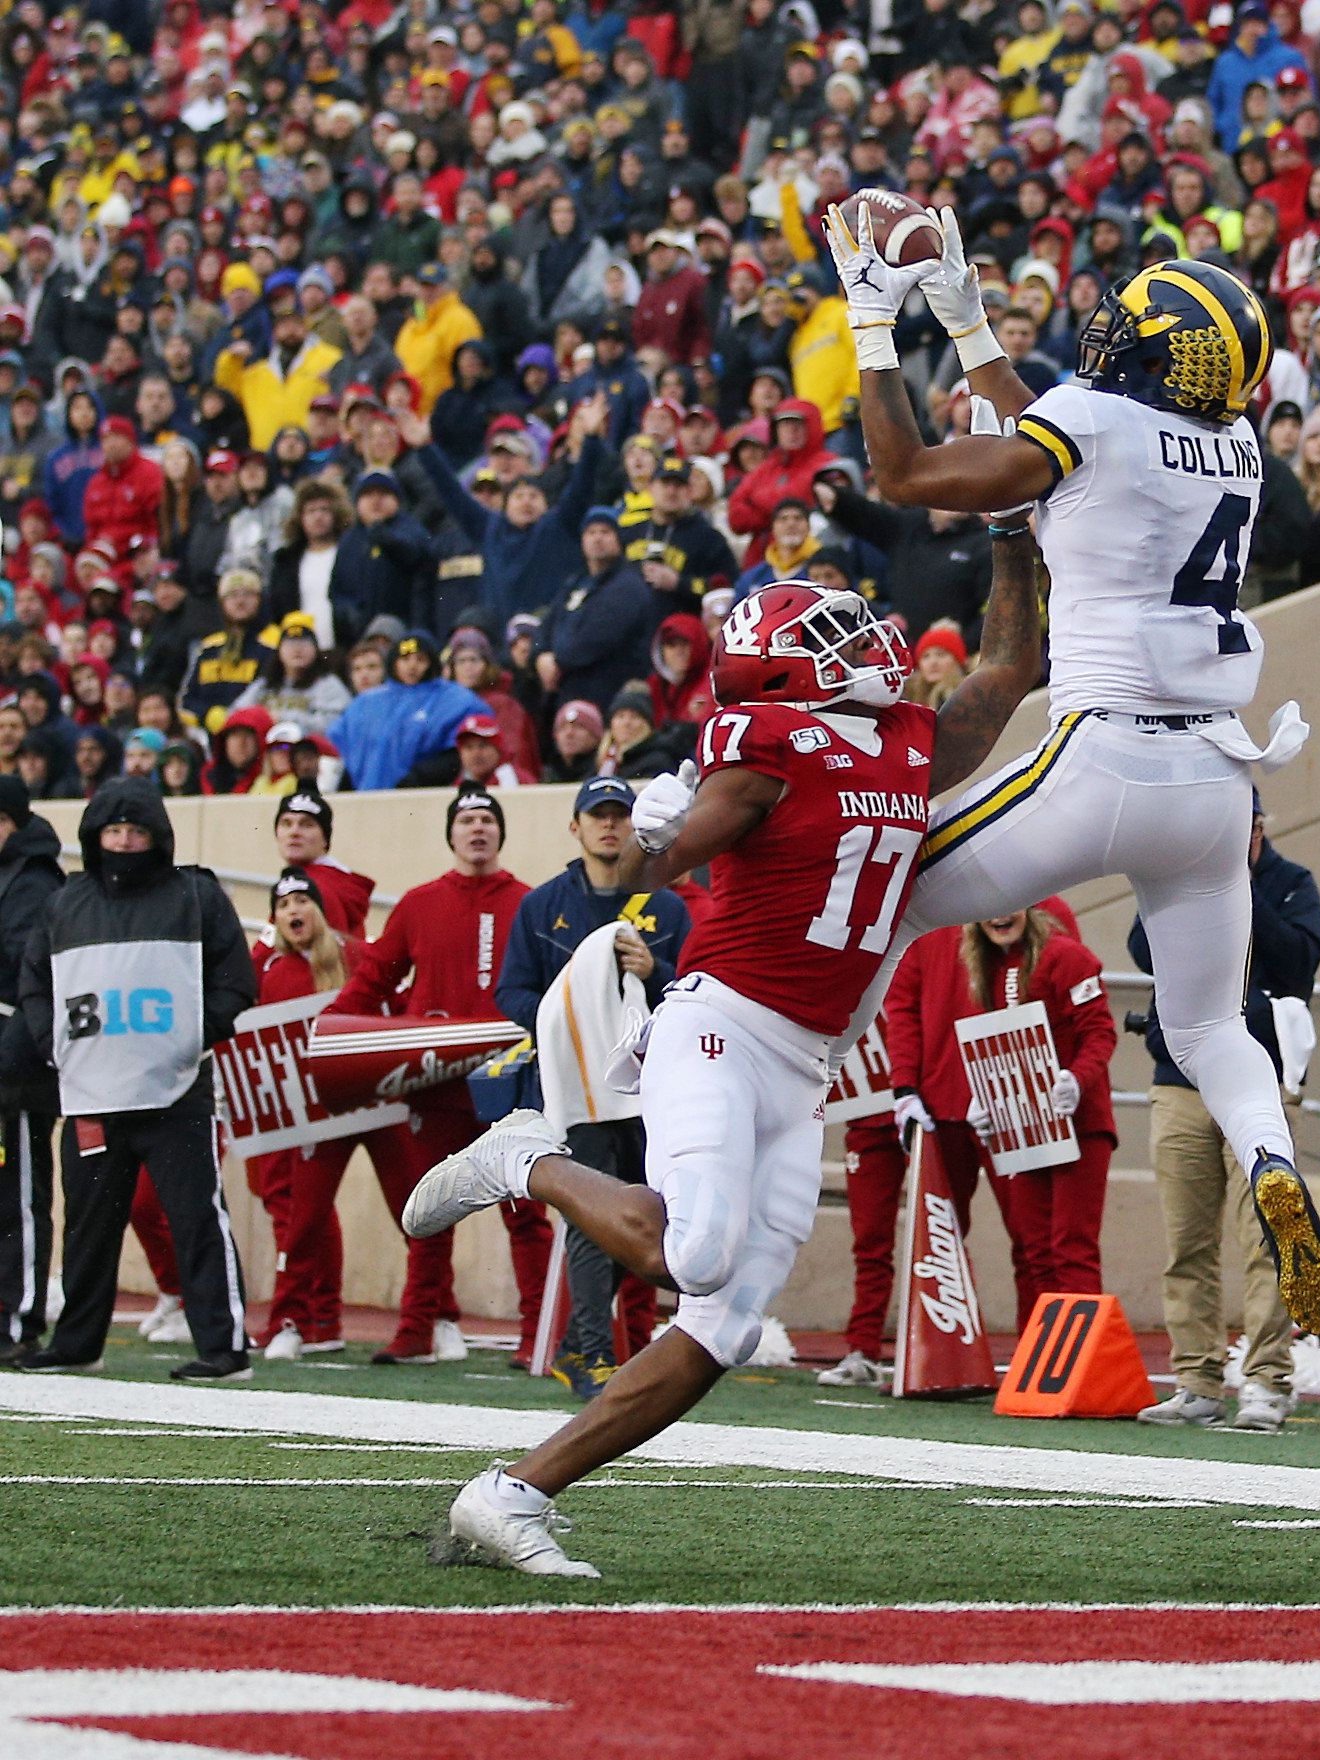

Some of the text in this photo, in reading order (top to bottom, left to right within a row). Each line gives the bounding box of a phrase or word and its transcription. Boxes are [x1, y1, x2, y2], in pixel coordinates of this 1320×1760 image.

[1158, 430, 1260, 480] COLLINS
[1169, 492, 1252, 655] 4
[702, 713, 752, 767] 17
[790, 728, 831, 750] 150
[837, 791, 926, 823] INDIANA
[805, 824, 925, 955] 17
[913, 1192, 981, 1345] Indiana
[1015, 1298, 1100, 1394] 10
